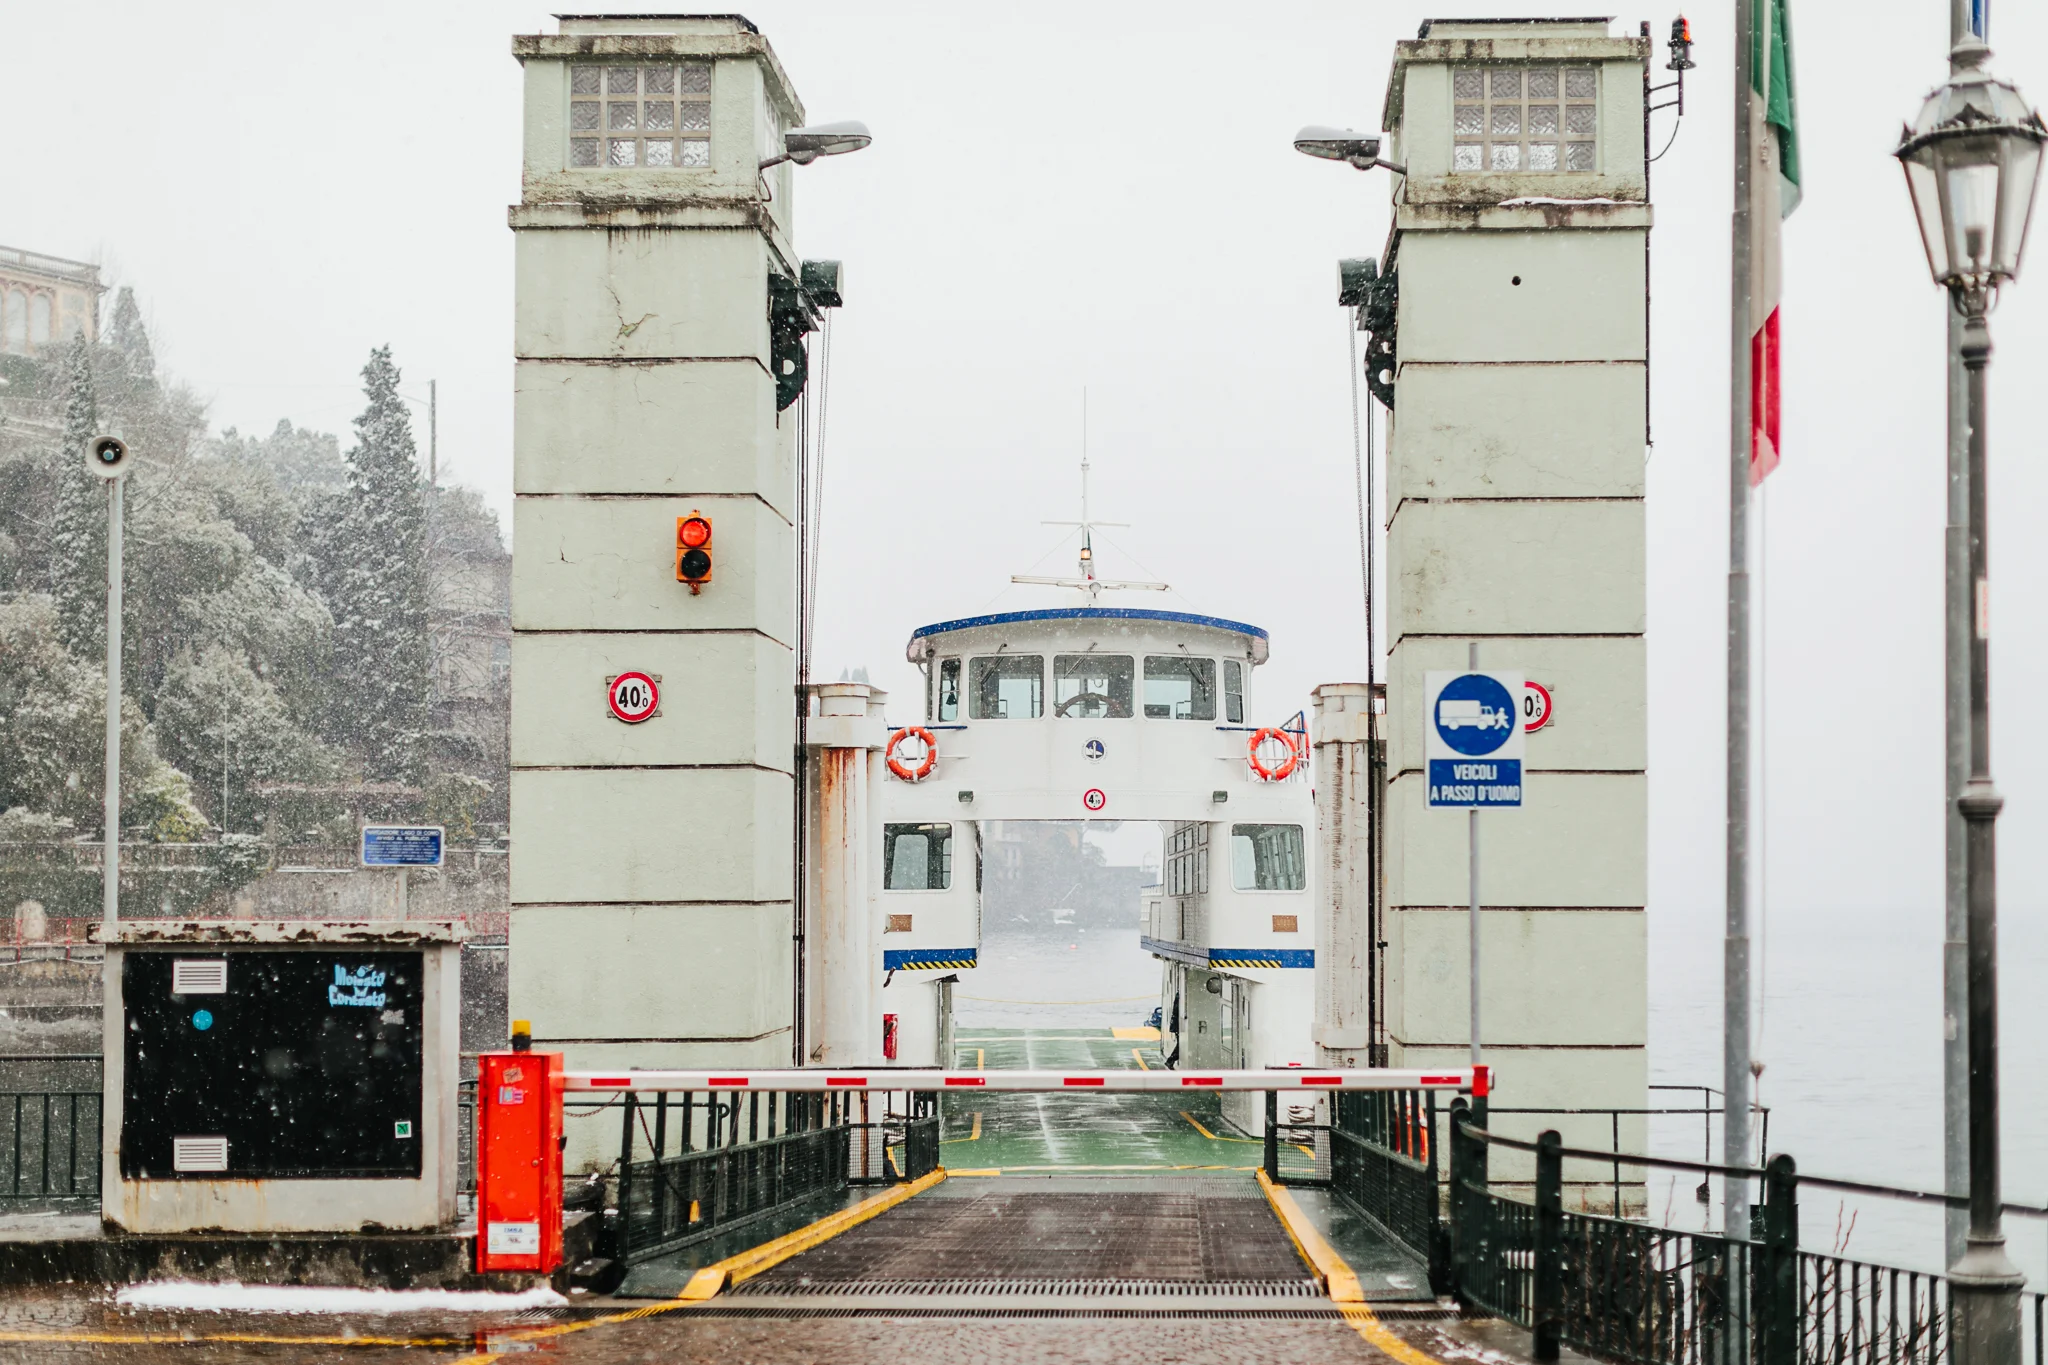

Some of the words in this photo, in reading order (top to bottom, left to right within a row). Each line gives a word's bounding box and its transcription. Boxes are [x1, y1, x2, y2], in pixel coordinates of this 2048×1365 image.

[1452, 764, 1497, 780] VEICOLI
[1431, 785, 1439, 801] A
[1441, 785, 1476, 801] PASSO
[1477, 785, 1520, 801] D'UOMO
